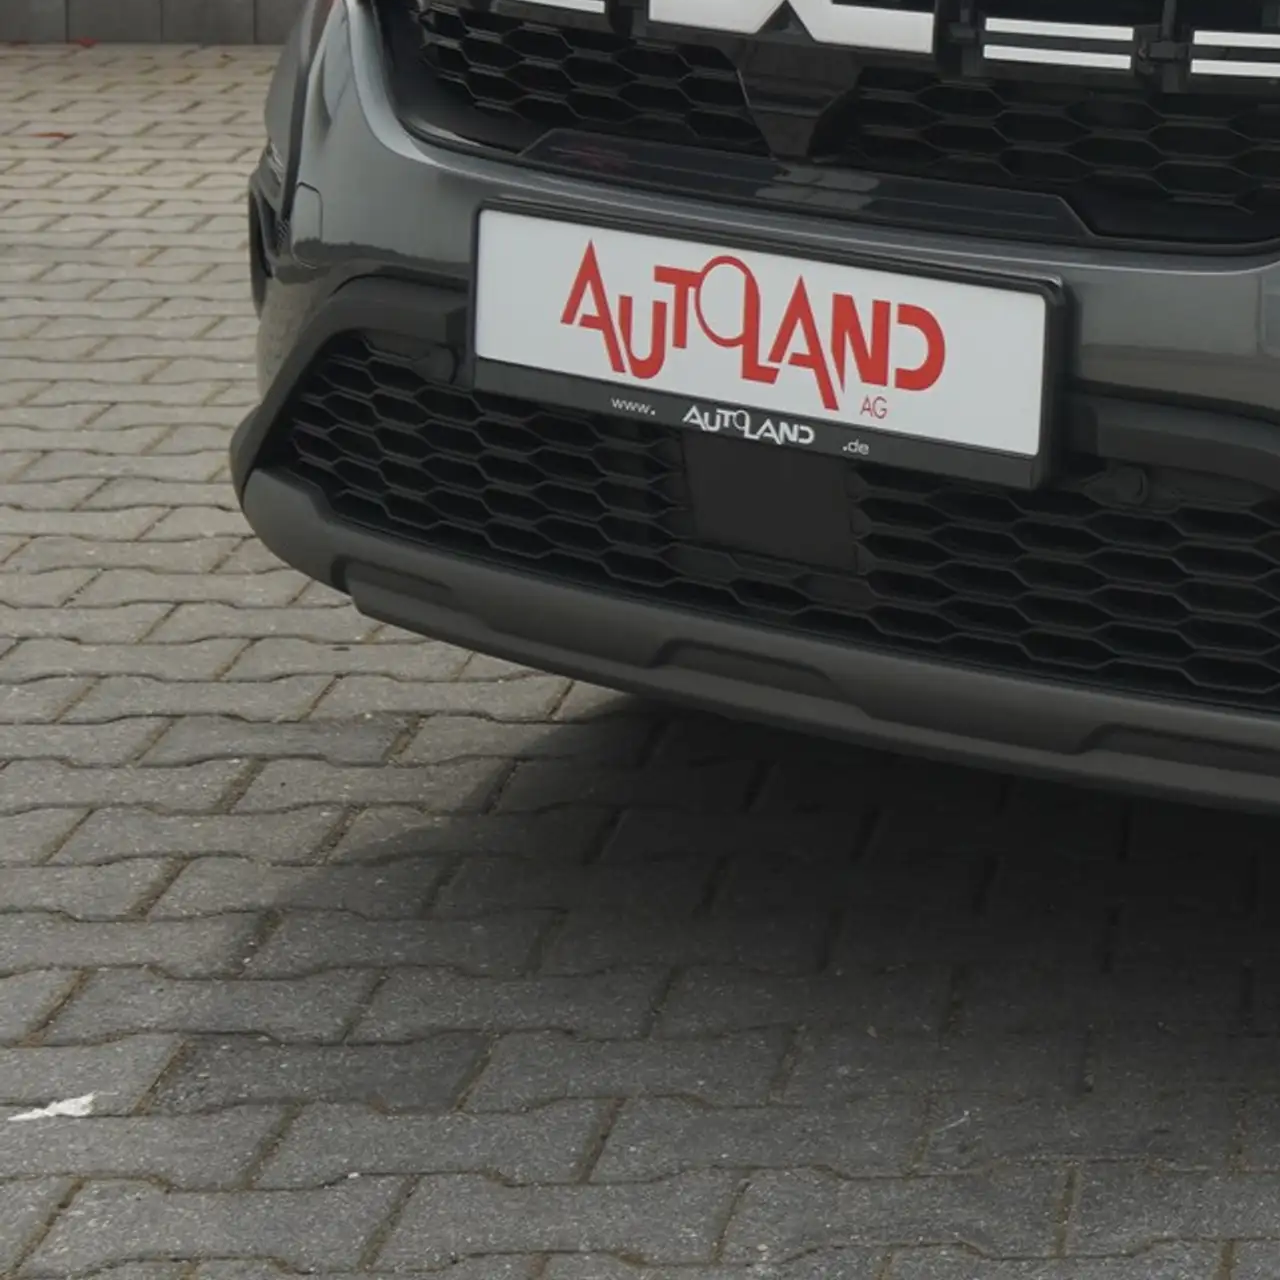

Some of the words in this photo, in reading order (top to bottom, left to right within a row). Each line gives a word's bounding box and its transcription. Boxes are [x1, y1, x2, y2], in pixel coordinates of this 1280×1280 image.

[560, 239, 946, 411] AUTOLAND
[611, 397, 656, 416] www.
[683, 405, 815, 445] AUTOLAND
[842, 439, 869, 456] .de
[860, 395, 888, 419] AG
